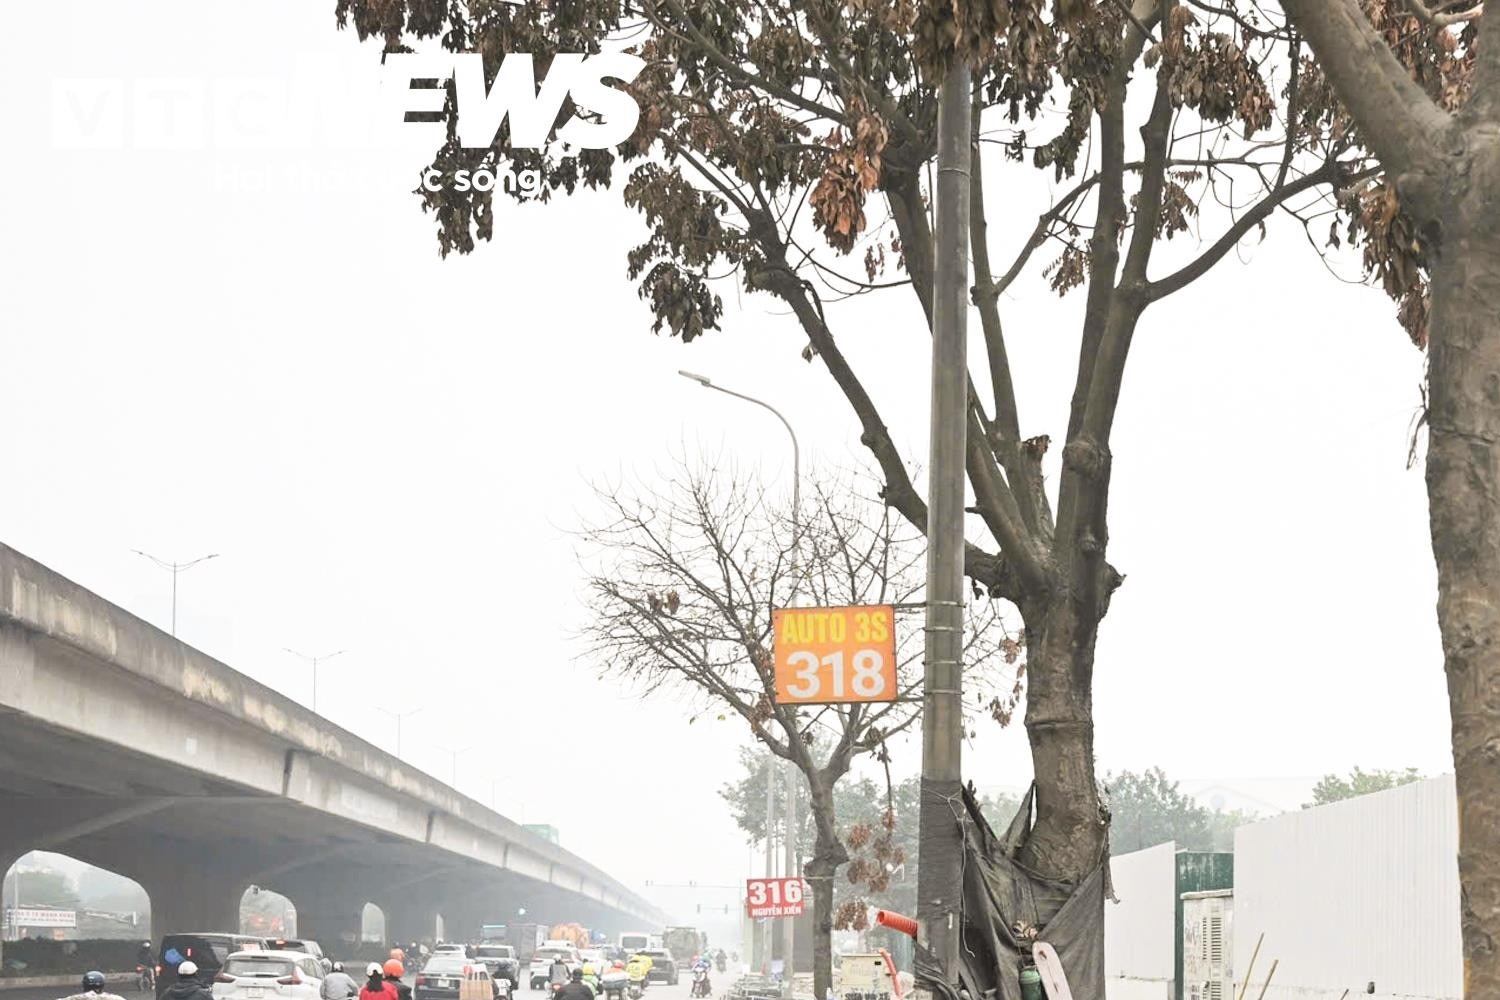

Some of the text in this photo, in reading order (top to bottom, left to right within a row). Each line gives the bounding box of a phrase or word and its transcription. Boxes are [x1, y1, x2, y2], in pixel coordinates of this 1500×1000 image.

[781, 611, 889, 645] AUTO 3S
[786, 648, 885, 699] 318
[749, 880, 802, 905] 316
